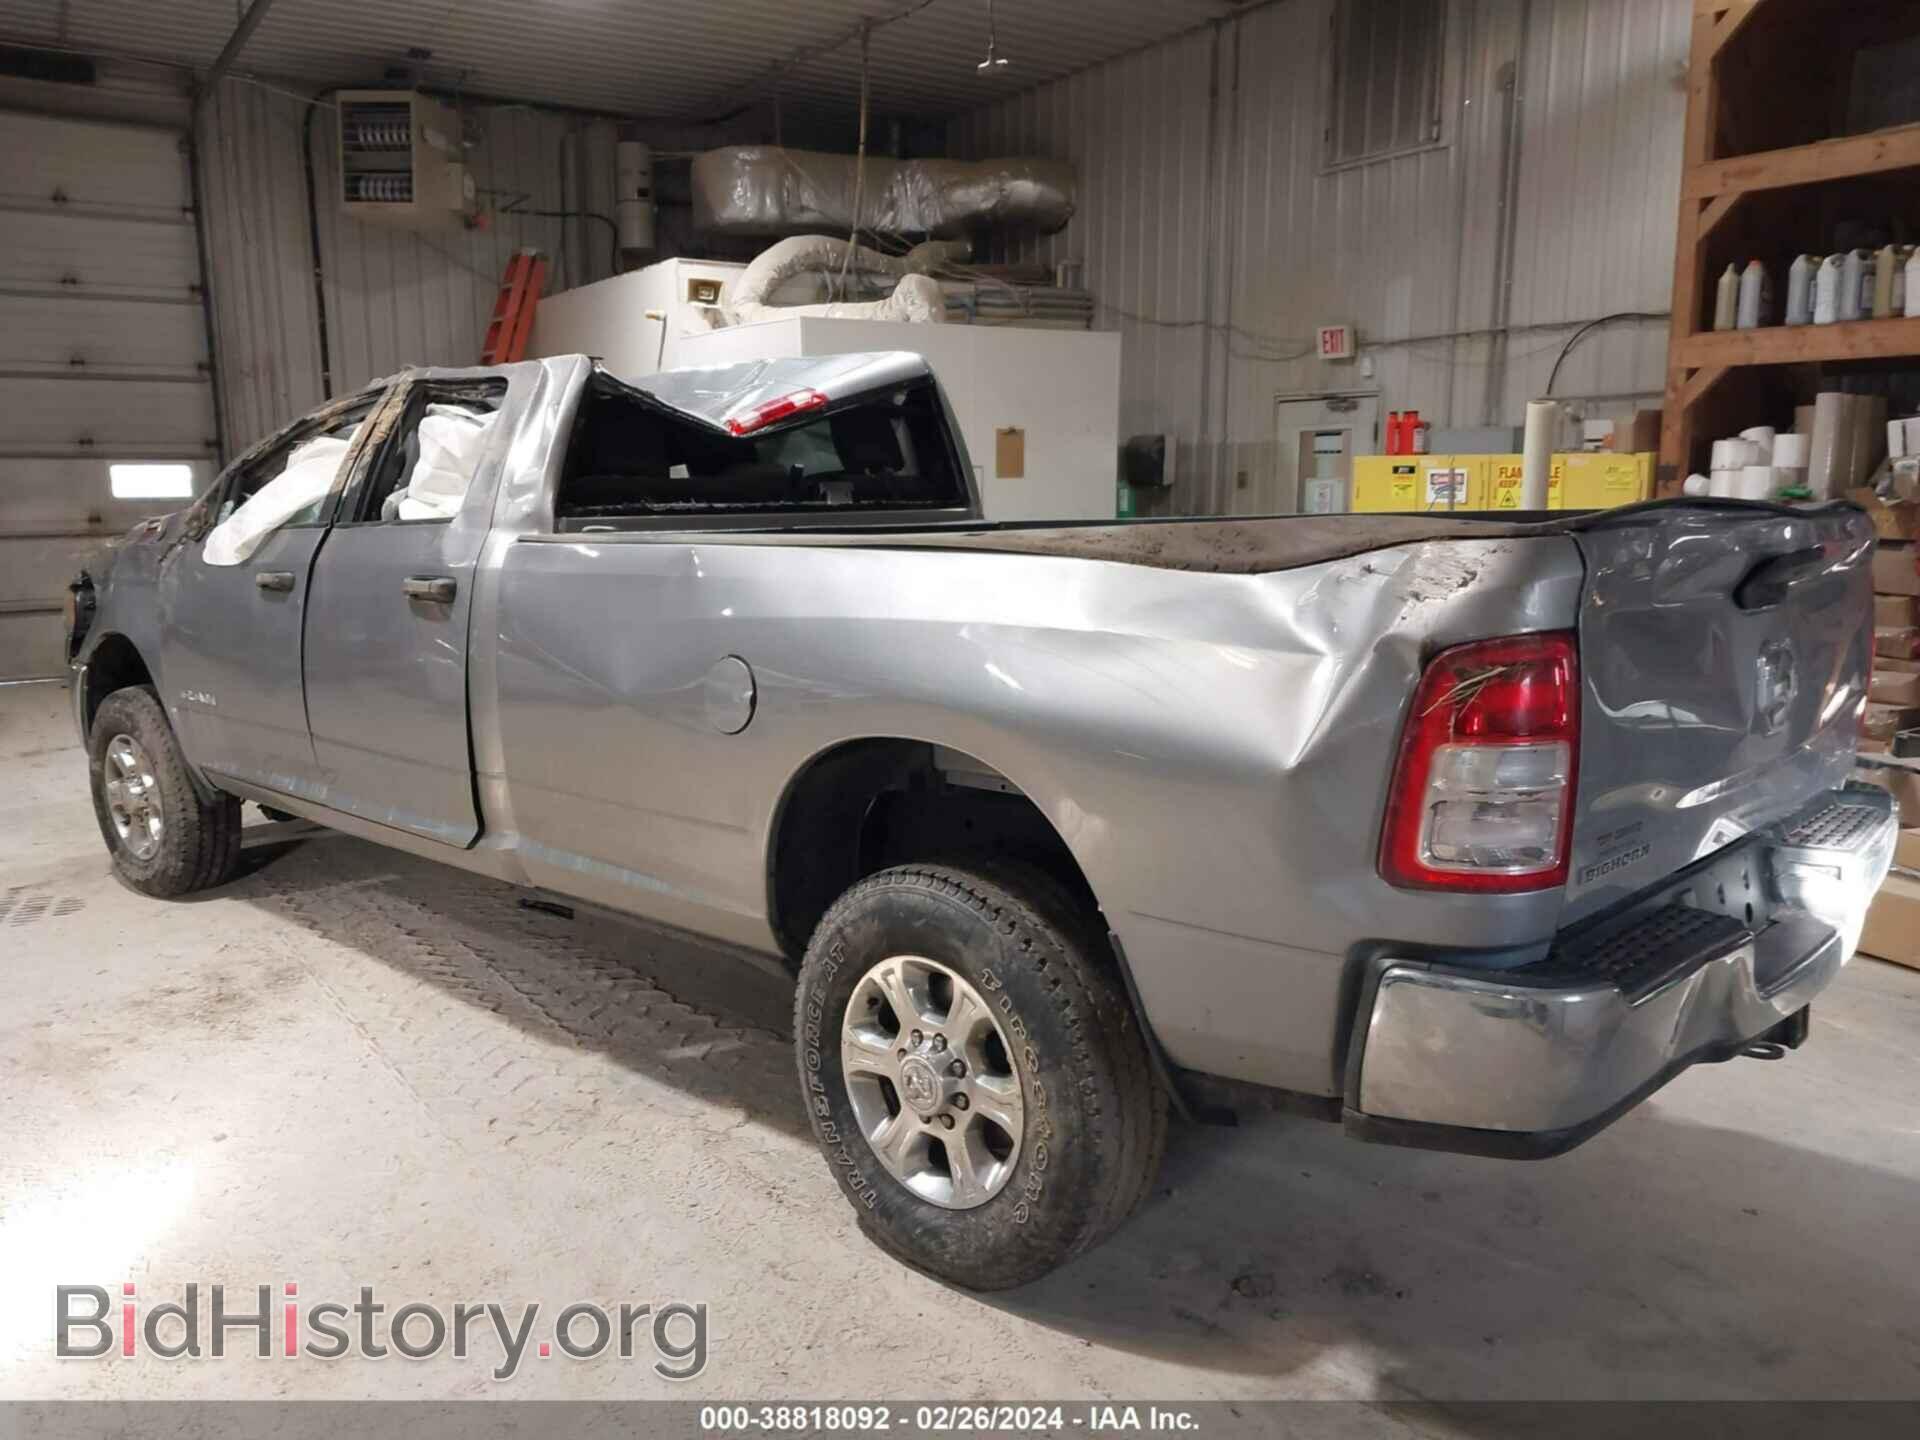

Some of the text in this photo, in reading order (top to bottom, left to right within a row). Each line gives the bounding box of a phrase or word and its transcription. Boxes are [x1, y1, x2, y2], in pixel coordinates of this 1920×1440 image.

[1322, 329, 1345, 354] EXIT
[1499, 466, 1561, 479] FLALE
[804, 942, 879, 1209] TRANSFORCE AT
